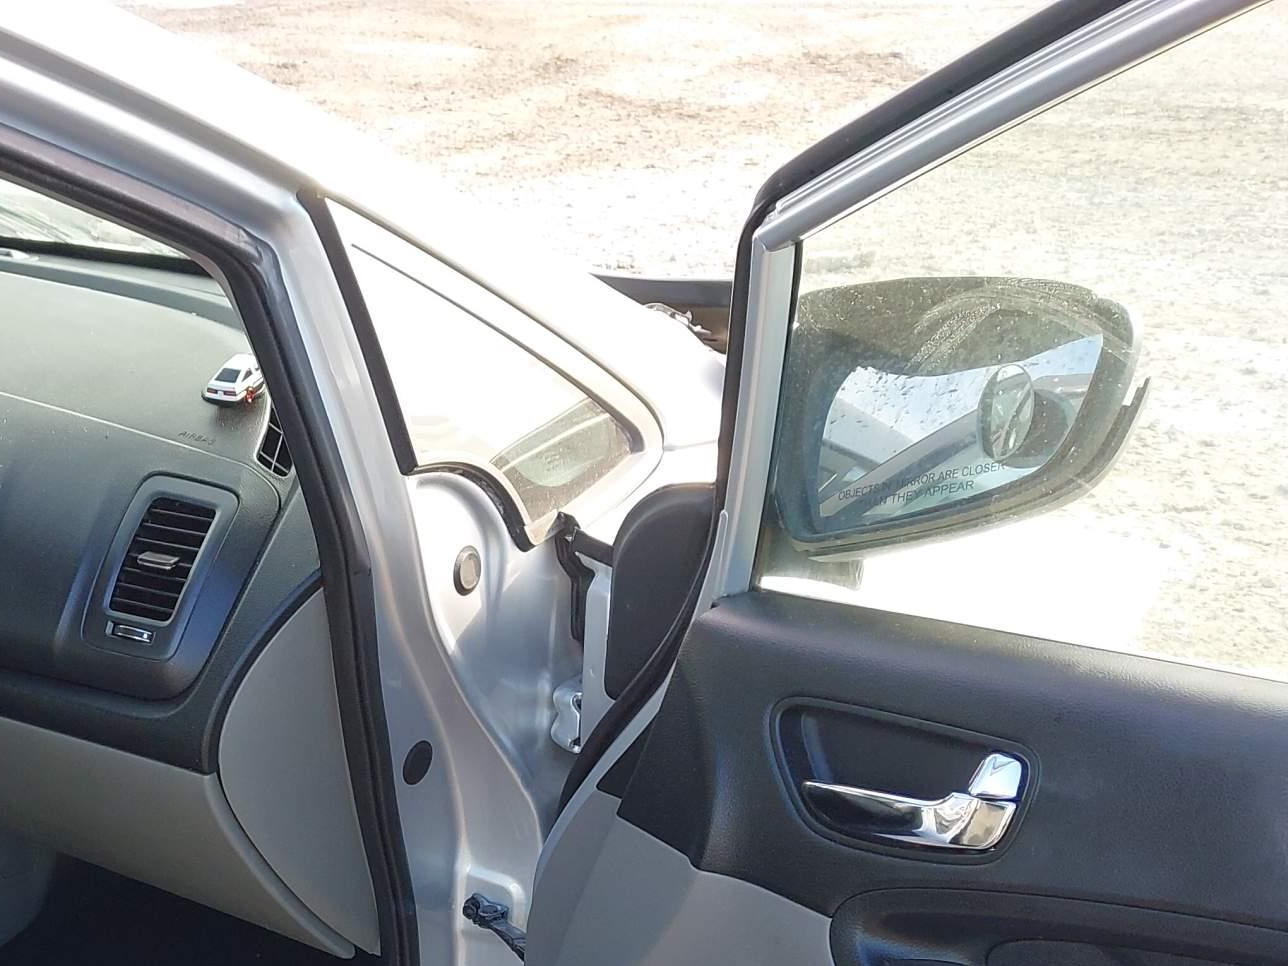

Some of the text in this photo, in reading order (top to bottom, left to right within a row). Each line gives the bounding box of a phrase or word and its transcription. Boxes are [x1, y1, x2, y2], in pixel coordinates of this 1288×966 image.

[838, 483, 881, 501] OBJECTS
[937, 467, 960, 482] ARE
[889, 488, 923, 504] THEY
[924, 480, 975, 498] APPEAR
